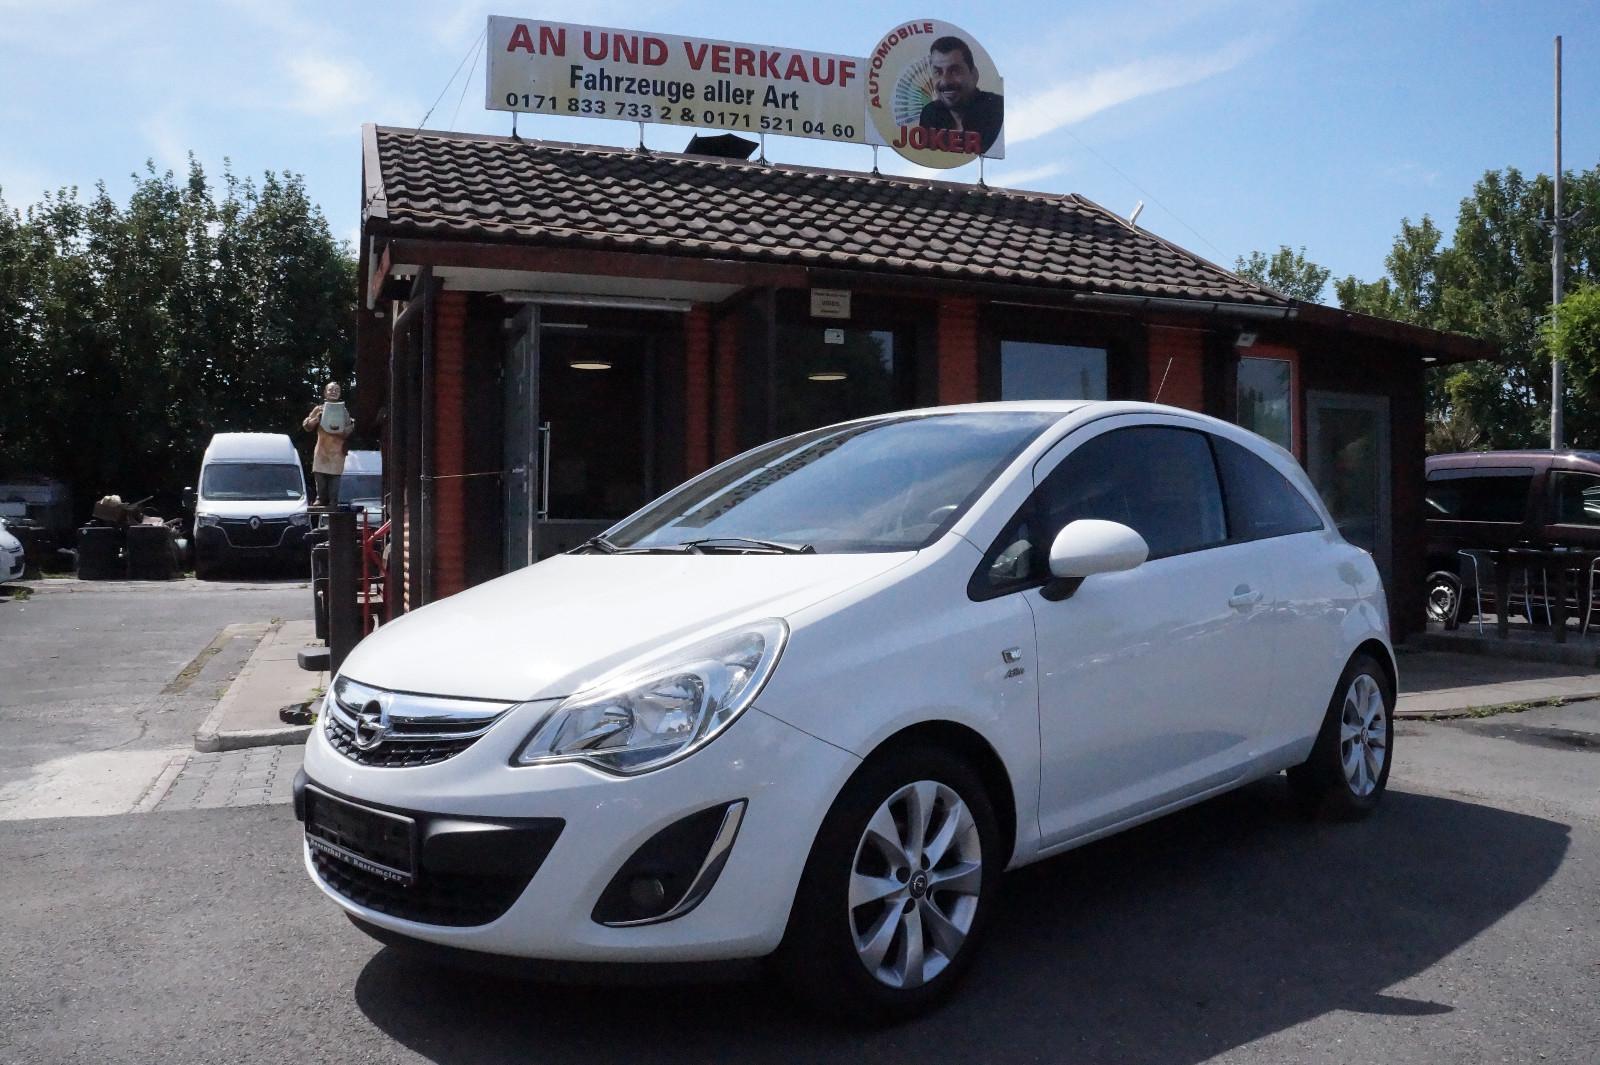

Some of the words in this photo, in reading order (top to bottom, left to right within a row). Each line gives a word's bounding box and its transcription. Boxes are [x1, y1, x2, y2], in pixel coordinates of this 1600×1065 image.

[506, 23, 566, 57] AN
[583, 31, 669, 67] UND
[684, 41, 856, 88] VERKAUF
[869, 22, 934, 109] AUTOMOBILE
[570, 65, 695, 104] Fahrzeuge
[703, 79, 755, 105] aller
[762, 85, 799, 111] Art
[506, 92, 557, 110] 0171
[567, 98, 606, 114] 833
[615, 102, 652, 118] 733
[660, 106, 672, 120] 2
[680, 107, 695, 123] &
[703, 110, 751, 128] 0171
[760, 115, 794, 132] 521
[803, 120, 826, 136] 04
[832, 123, 855, 139] 60
[892, 125, 982, 155] JOKER
